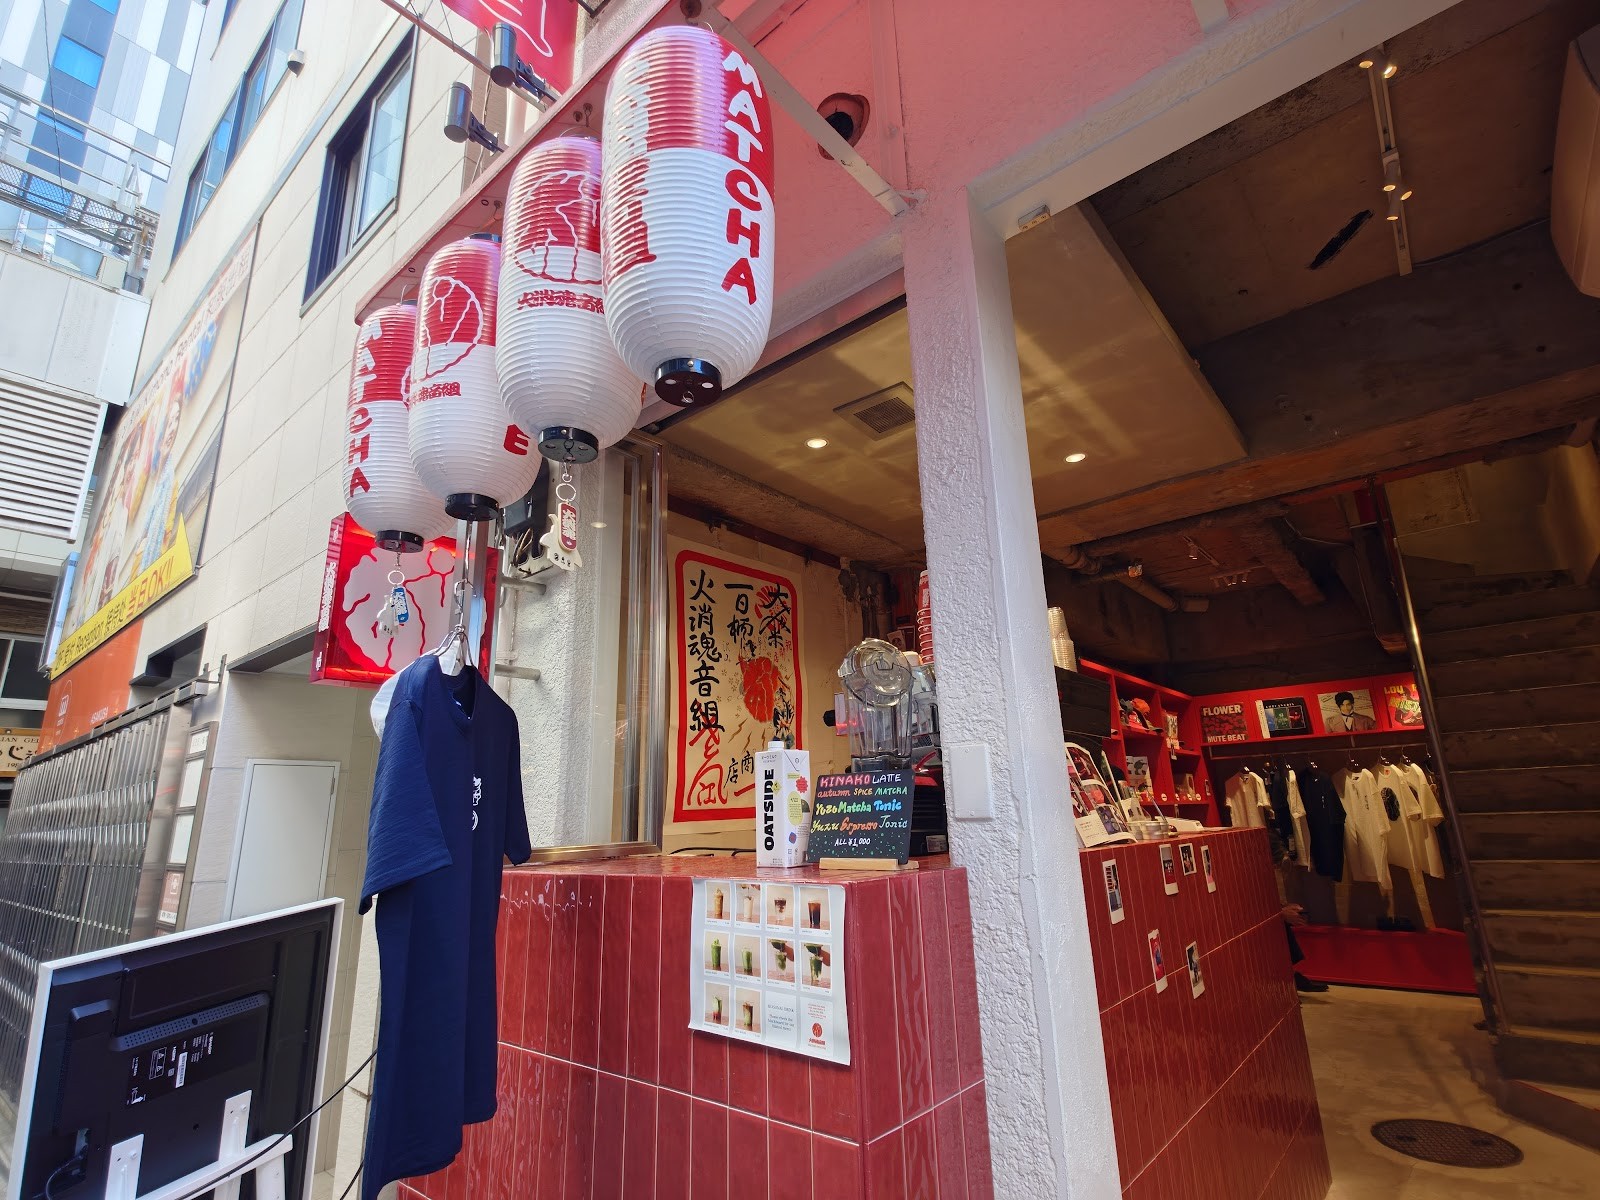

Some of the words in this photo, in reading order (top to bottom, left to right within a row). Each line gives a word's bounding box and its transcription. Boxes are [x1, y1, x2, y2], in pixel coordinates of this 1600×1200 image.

[721, 51, 763, 305] MATCHA
[688, 569, 725, 733] 火消魂音組
[1203, 705, 1242, 716] FLOWER
[1207, 735, 1227, 743] MUTE
[820, 774, 871, 787] KINAKO
[872, 773, 902, 784] LATTE
[817, 789, 851, 798] autumn
[854, 788, 873, 796] SPICE
[875, 786, 908, 796] MATCHA
[763, 769, 775, 851] OATSIDE
[838, 800, 872, 813] Matcha
[874, 798, 902, 811] Tonic
[840, 816, 878, 835] Espresso
[879, 814, 908, 828] Tonic
[834, 838, 847, 847] ALL
